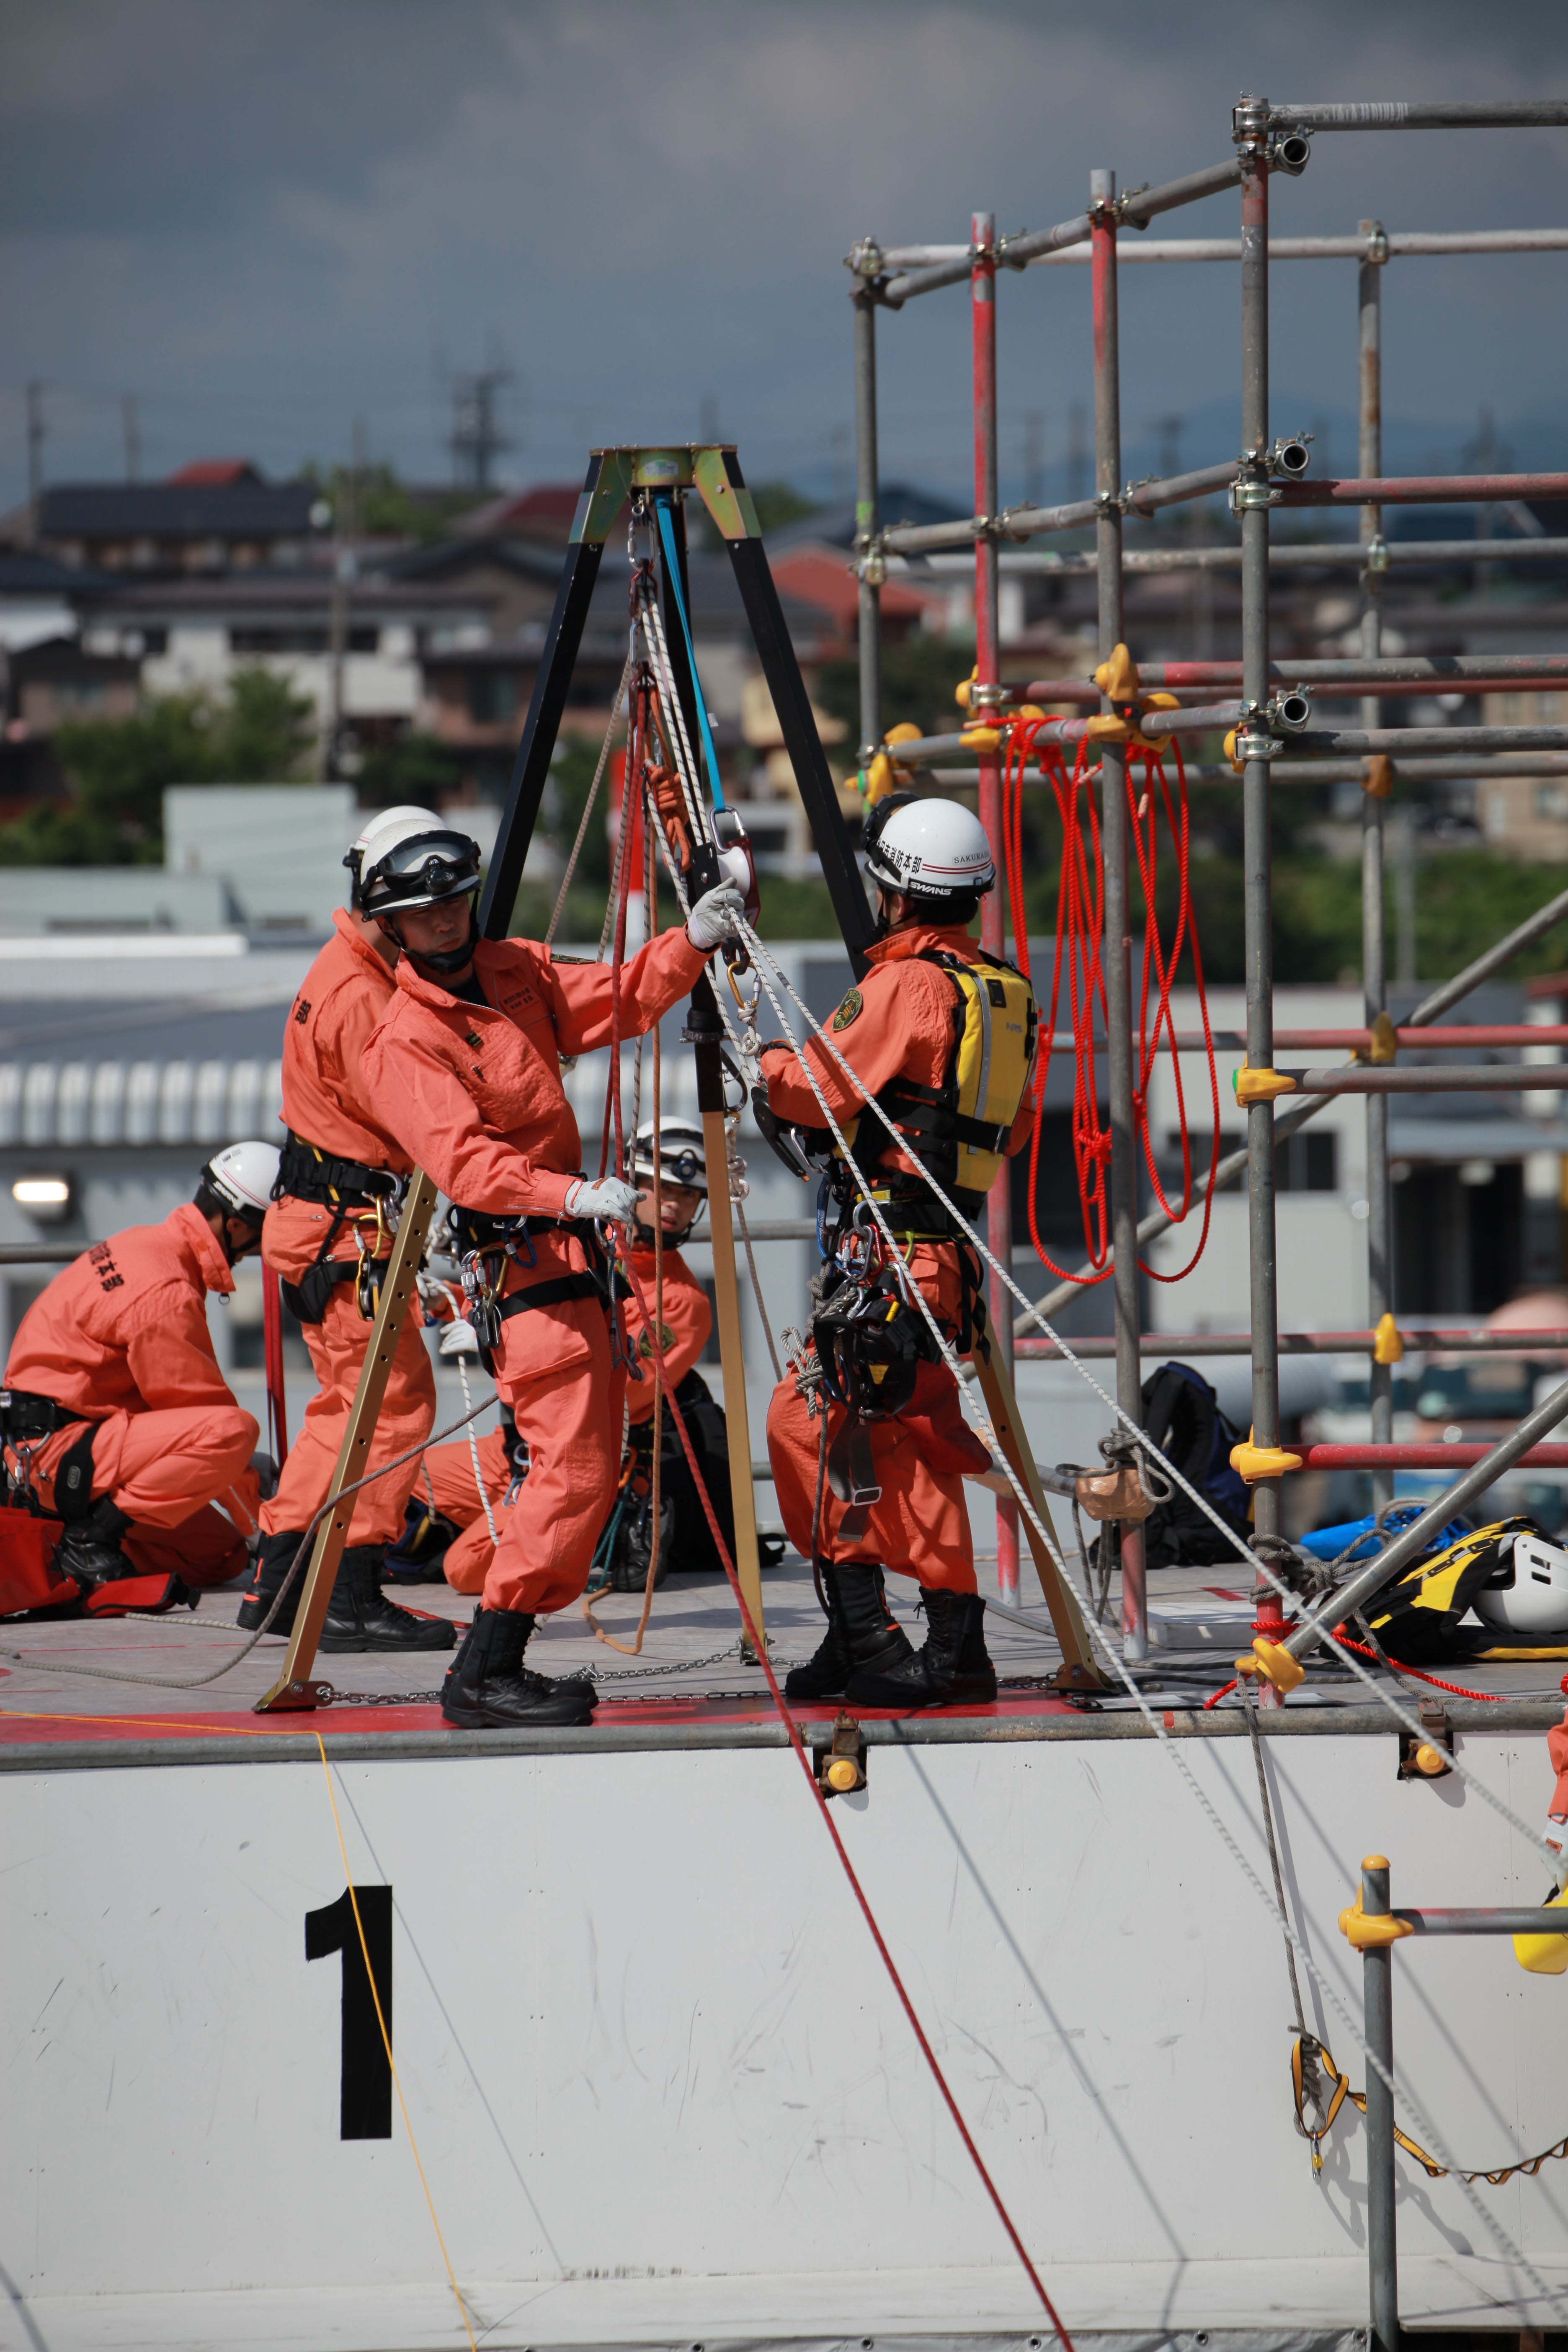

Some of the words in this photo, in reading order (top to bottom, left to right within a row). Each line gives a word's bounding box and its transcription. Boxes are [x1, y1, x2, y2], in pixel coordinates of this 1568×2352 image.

[954, 851, 990, 864] SAKURADA
[909, 881, 952, 895] SWANS
[292, 991, 312, 1025] 部
[213, 1181, 237, 1204] SWAN
[304, 1885, 393, 2141] 1
